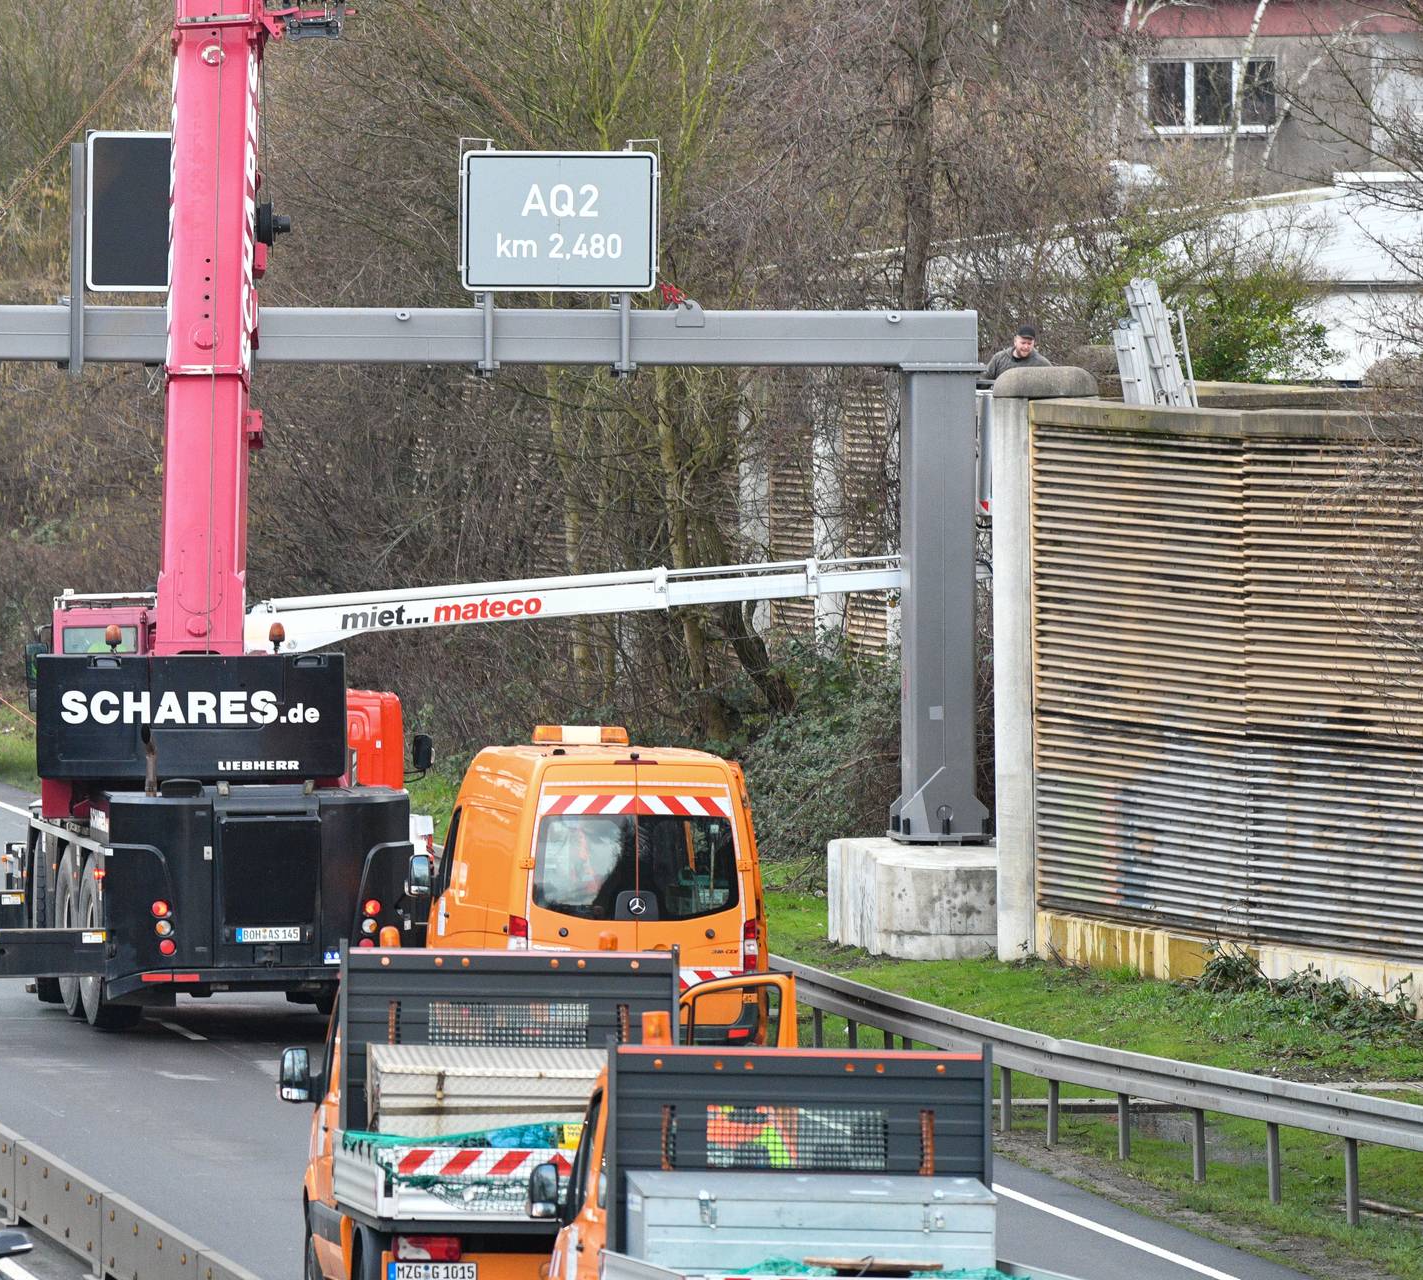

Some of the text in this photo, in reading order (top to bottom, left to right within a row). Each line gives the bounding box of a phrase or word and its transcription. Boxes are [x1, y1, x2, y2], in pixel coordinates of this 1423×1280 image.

[521, 183, 599, 217] AQ2
[496, 232, 622, 260] km 2,480
[341, 598, 542, 630] miet... mateco
[60, 690, 320, 725] SCHARES.de
[217, 760, 300, 771] LIEBHERR
[243, 928, 299, 940] BOH AS 145
[397, 1265, 475, 1279] MZG G 1015
